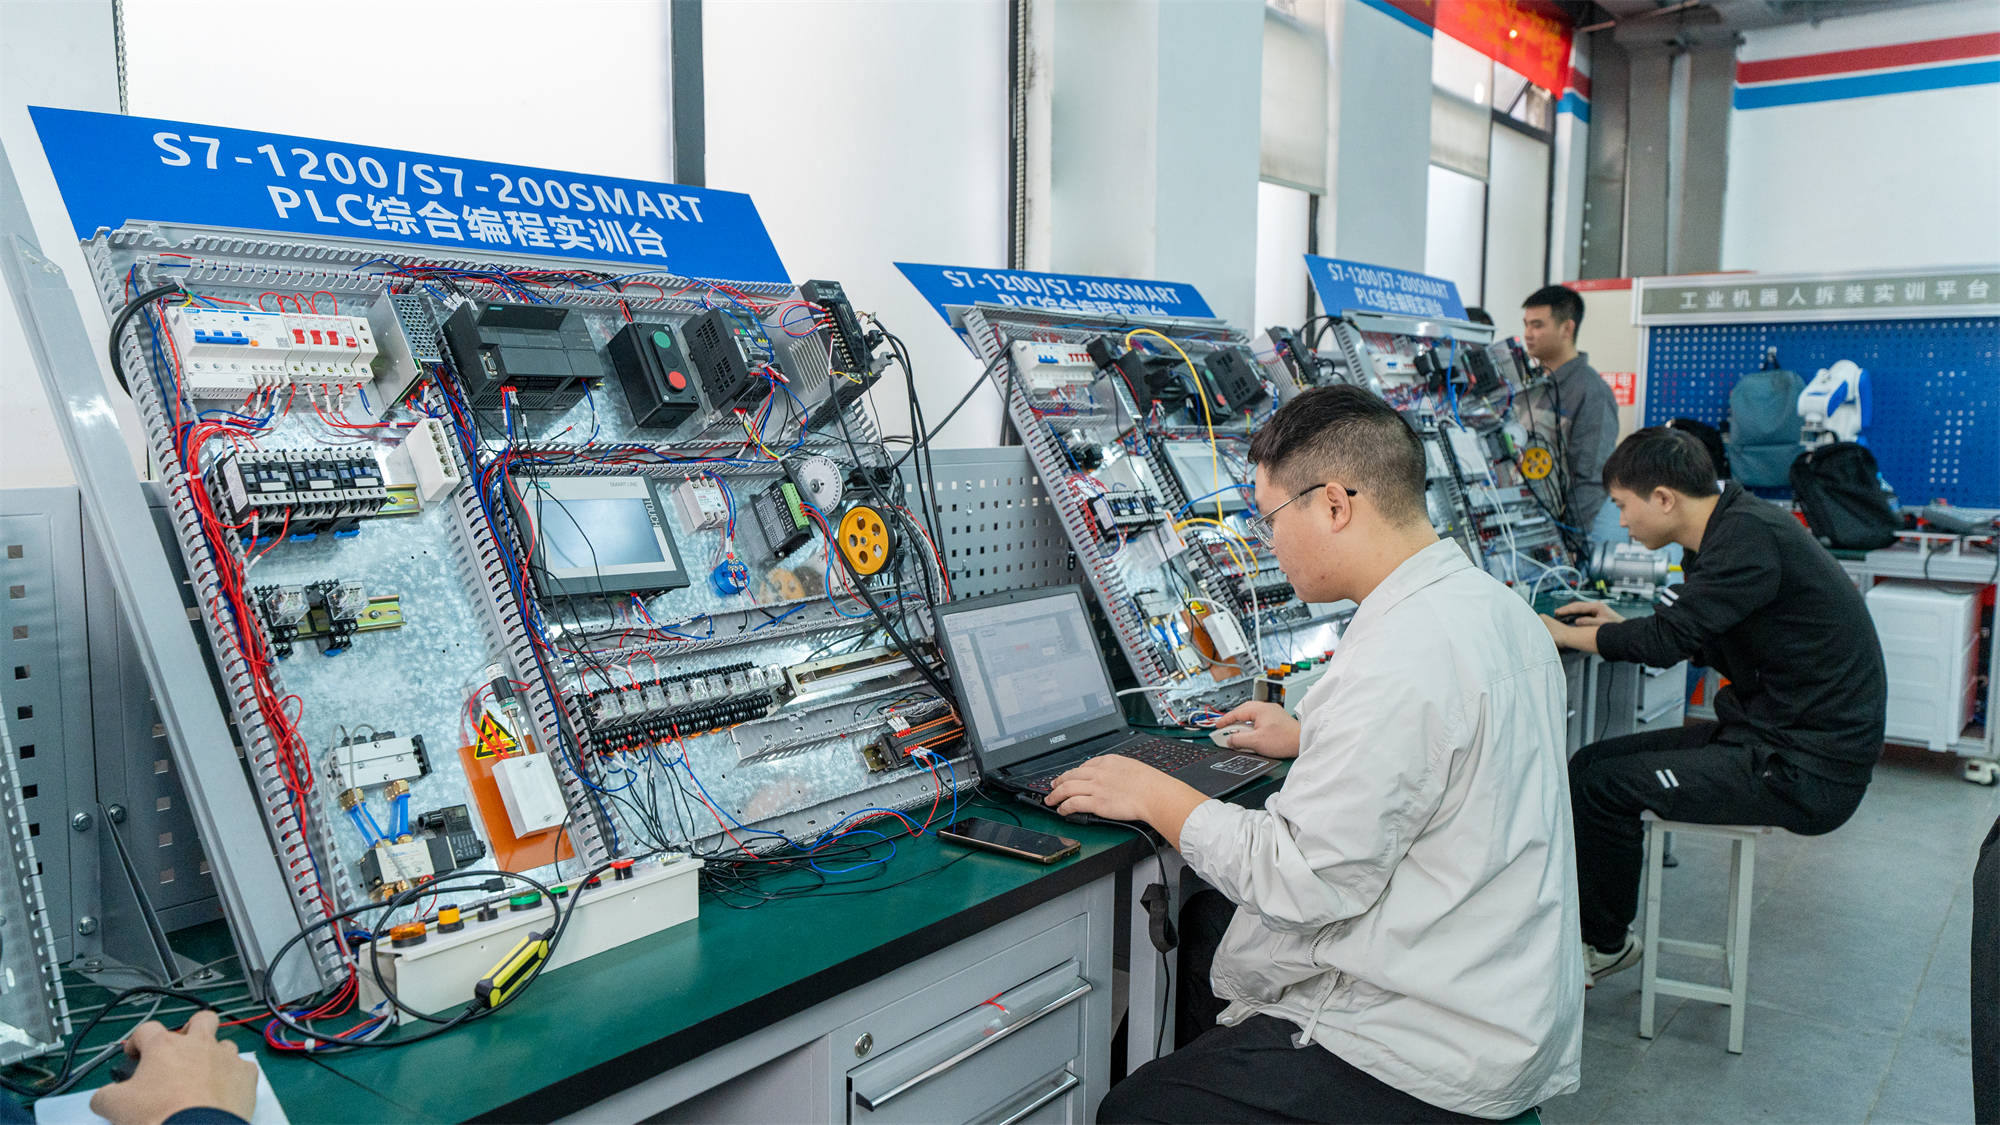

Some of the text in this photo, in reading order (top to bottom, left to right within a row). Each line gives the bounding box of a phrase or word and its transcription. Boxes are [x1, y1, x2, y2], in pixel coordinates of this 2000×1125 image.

[152, 131, 704, 223] S7-1200/S7-200SMART
[266, 185, 668, 258] PLC综合编程实训台
[942, 270, 1182, 305] S7-1200/S7-200SMART
[1327, 262, 1450, 299] S7-1200/S7-200SMART
[1679, 279, 1990, 310] 工业机器人拆装实训平台
[644, 499, 661, 527] TOUCH
